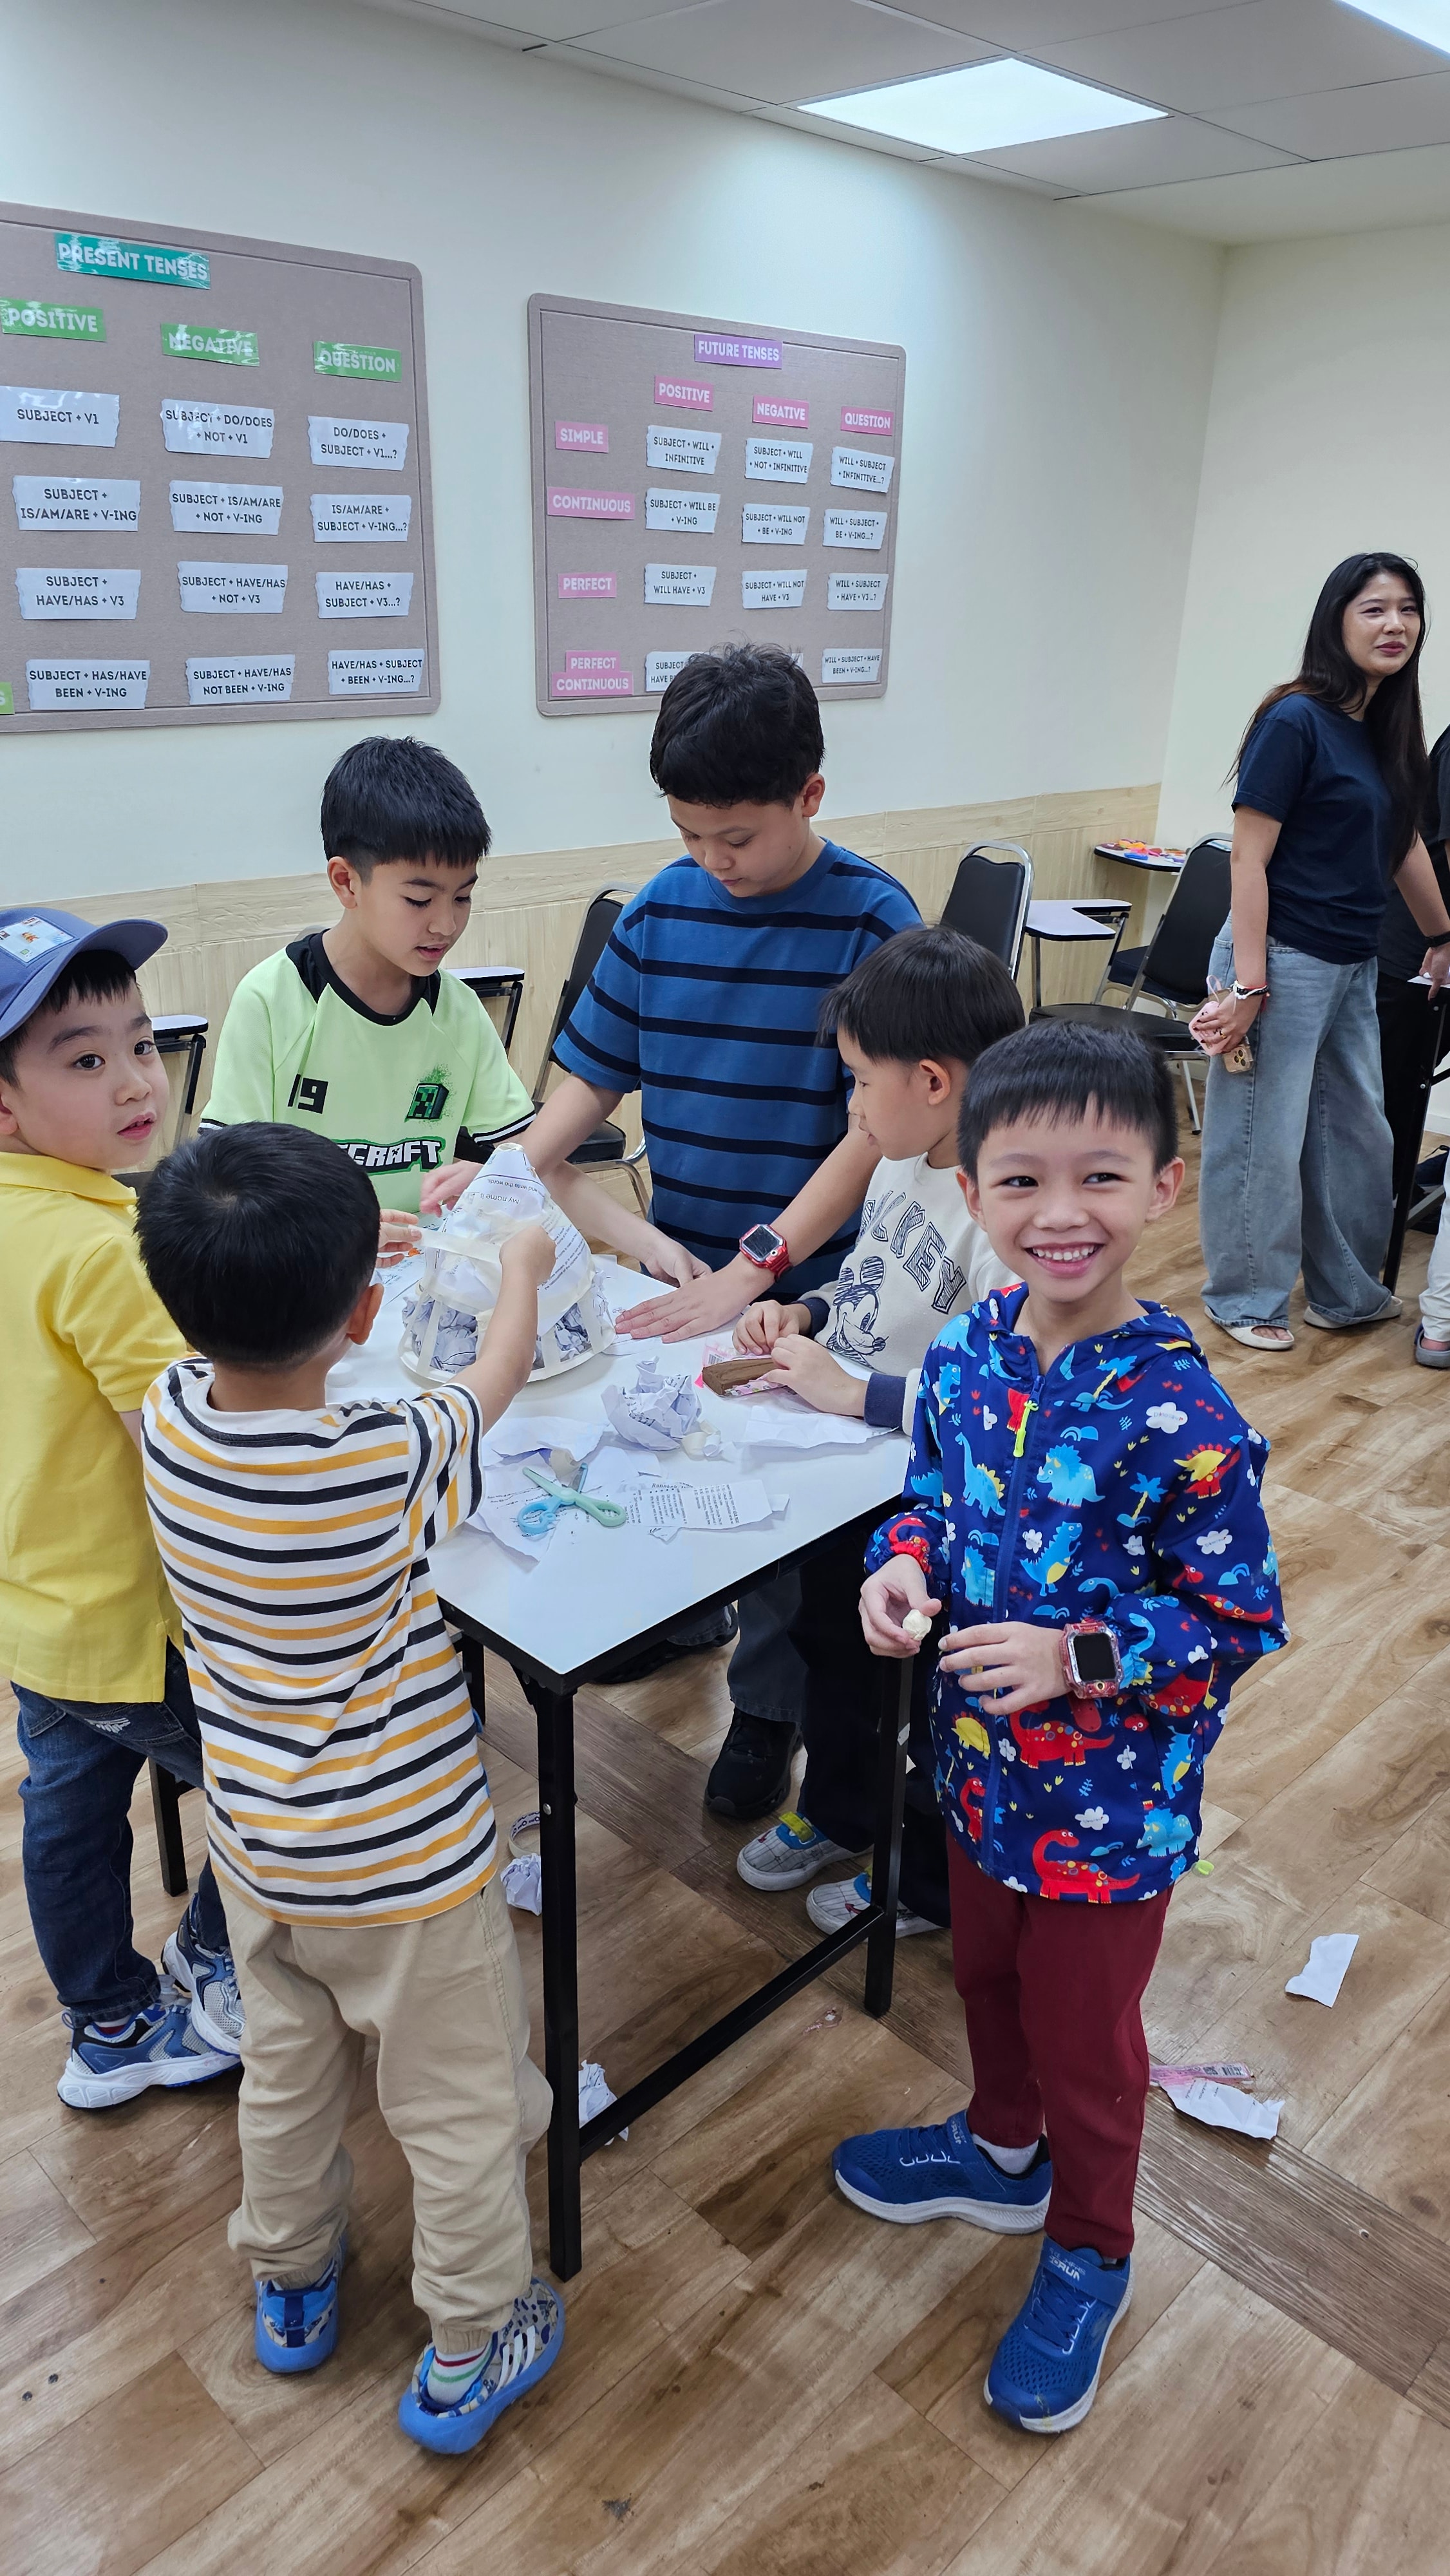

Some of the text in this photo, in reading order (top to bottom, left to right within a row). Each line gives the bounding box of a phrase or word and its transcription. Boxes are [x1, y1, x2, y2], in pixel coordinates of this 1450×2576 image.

[58, 243, 208, 280] PRESENT TENSES
[8, 308, 98, 332] POSITIVE
[169, 332, 252, 355] NEGATIVE
[698, 341, 779, 361] FUTURE TENSES
[321, 351, 396, 373] QUESTION
[659, 383, 710, 403] POSITIVE
[17, 408, 72, 422] SUBJECT
[84, 413, 99, 424] V1
[757, 403, 805, 421] NEGATIVE
[224, 414, 272, 428] DO/DOES
[845, 413, 890, 429] QUESTION
[203, 431, 225, 442] NOT
[235, 433, 247, 444] V1
[334, 426, 379, 440] DO/DOES
[560, 428, 603, 444] SIMPLE
[321, 444, 364, 456] SUBJECT
[654, 436, 685, 448] SUBJECT
[692, 440, 709, 451] WILL
[665, 453, 704, 465] INFINITIVE
[753, 446, 781, 456] SUBJECT
[787, 450, 802, 459] WILL
[754, 460, 767, 469] NOT
[773, 462, 807, 473] INFINITIVE
[839, 455, 854, 465] WILL
[859, 459, 886, 470] SUBJECT
[44, 488, 98, 500] SUBJECT
[173, 494, 218, 505] SUBJECT
[227, 496, 281, 507] IS/AM/ARE
[332, 504, 382, 514] IS/AM/ARE
[552, 495, 631, 513] CONTINUOUS
[650, 498, 682, 509] SUBJECT
[688, 501, 706, 510] WILL
[708, 502, 715, 511] BE
[20, 507, 89, 520] IS/AM/ARE
[100, 509, 137, 520] V-ING
[203, 511, 223, 522] NOT
[232, 513, 262, 523] V-ING
[746, 513, 772, 521] SUBJECT
[317, 521, 359, 531] SUBJECT
[676, 516, 697, 525] V-ING
[829, 516, 843, 525] WILL
[849, 518, 875, 526] SUBJECT
[46, 576, 99, 587] SUBJECT
[182, 576, 226, 586] SUBJECT
[236, 578, 285, 587] HAVE/HAS
[661, 571, 692, 579] SUBJECT
[335, 580, 384, 590] HAVE/HAS
[563, 577, 612, 591] PERFECT
[654, 585, 670, 593] WILL
[672, 585, 690, 594] HAVE
[697, 586, 705, 594] V3
[36, 594, 98, 605] HAVE/HAS
[109, 595, 124, 605] V3
[219, 594, 238, 603] NOT
[248, 594, 260, 603] V3
[325, 598, 367, 607] SUBJECT
[332, 660, 377, 669] HAVE/HAS
[386, 659, 422, 668] SUBJECT
[570, 657, 616, 670] PERFECT
[655, 661, 684, 670] SUBJECT
[29, 670, 80, 680] SUBJECT
[91, 670, 147, 680] HAS/HAVE
[193, 669, 234, 679] SUBJECT
[244, 667, 291, 677] HAVE/HAS
[650, 675, 668, 684] HAVE
[348, 676, 369, 684] BEEN
[556, 677, 628, 691] CONTINUOUS
[55, 688, 83, 697] BEEN
[94, 688, 126, 697] V-ING
[203, 685, 222, 695] NOT
[225, 685, 248, 694] BEEN
[257, 683, 284, 692] V-ING
[288, 1074, 328, 1114] 19
[339, 1141, 440, 1166] CRAFT
